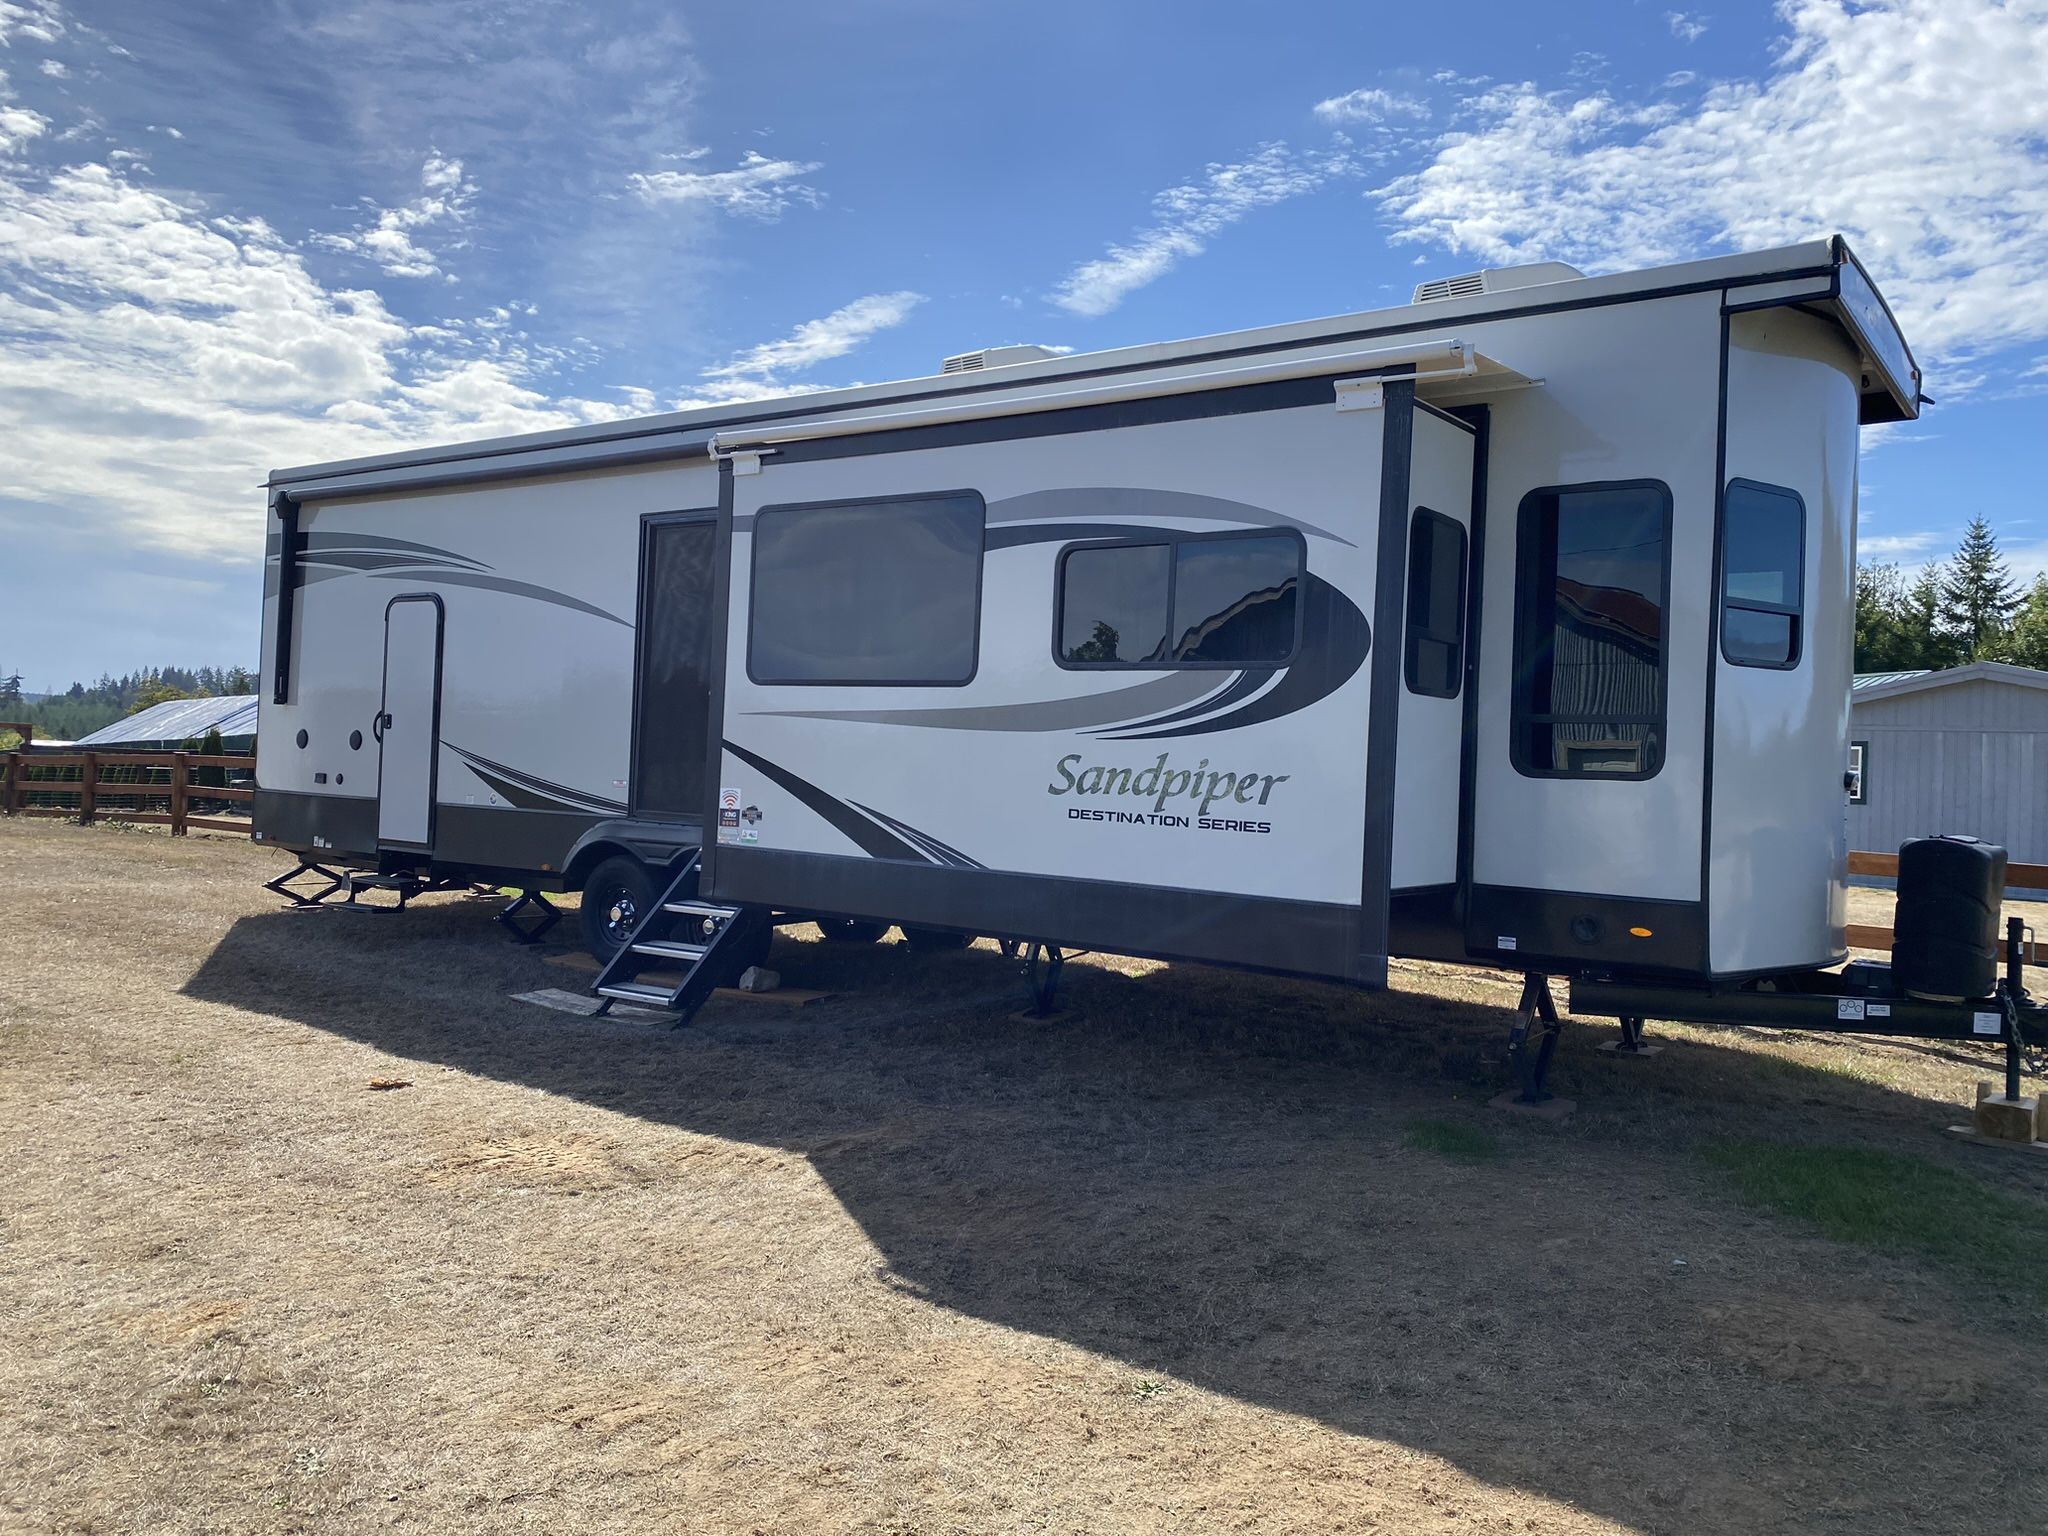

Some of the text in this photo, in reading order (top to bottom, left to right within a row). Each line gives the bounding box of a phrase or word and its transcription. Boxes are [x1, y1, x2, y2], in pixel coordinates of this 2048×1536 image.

[1048, 752, 1291, 816] Sandpiper
[1068, 808, 1271, 833] DESTINATION SERIES
